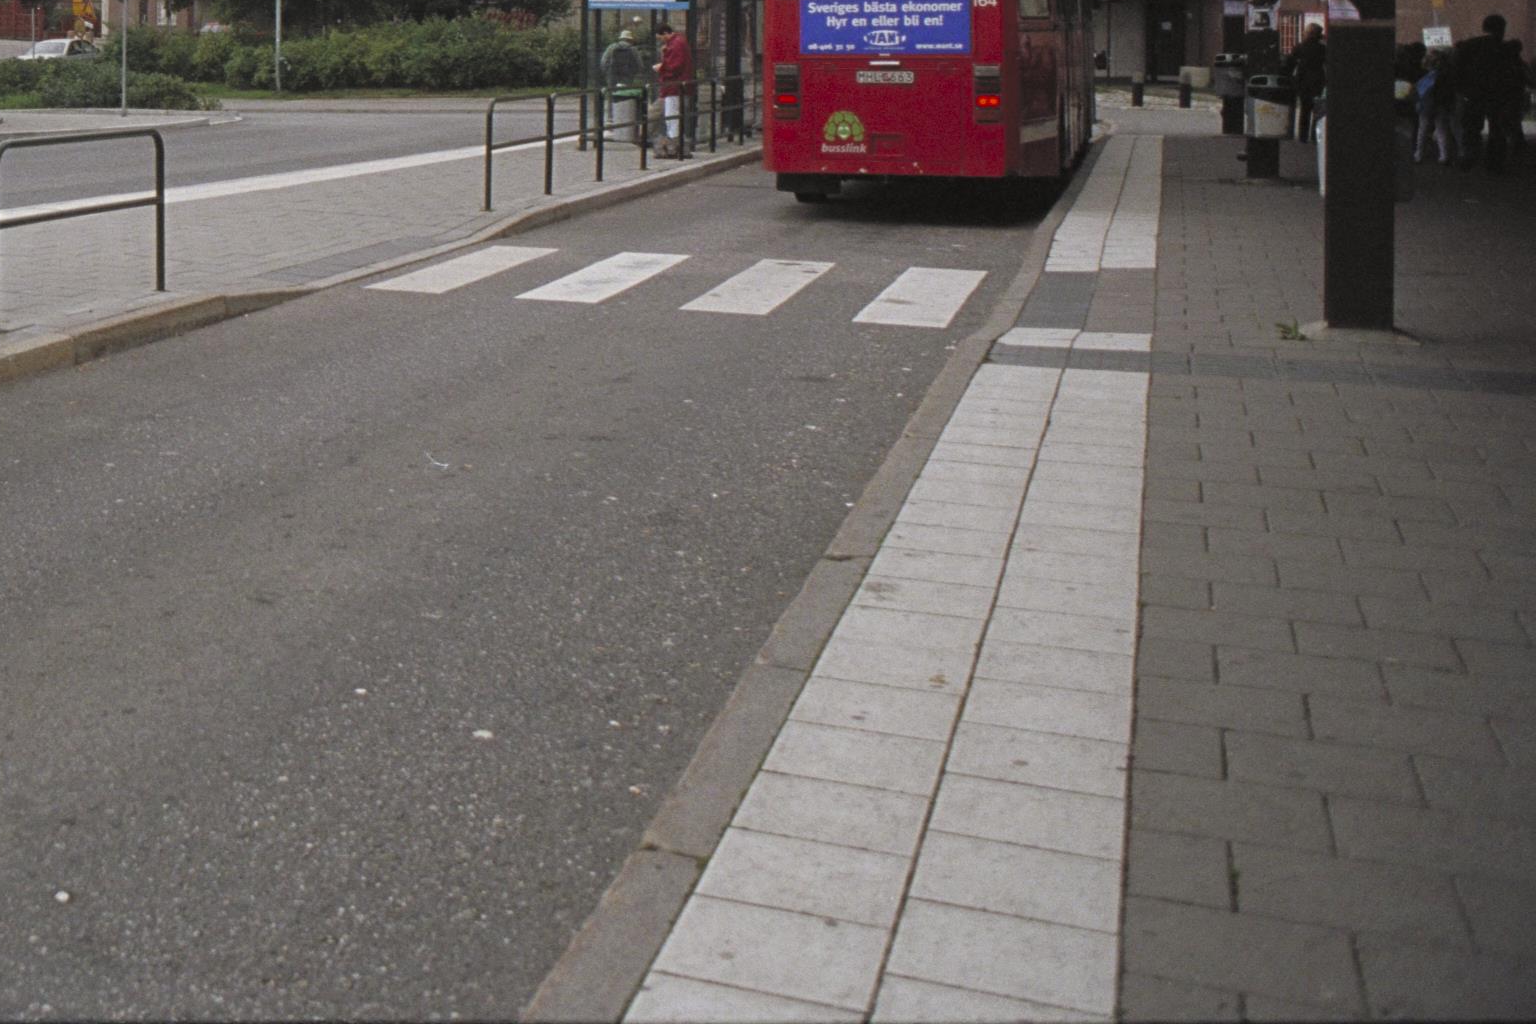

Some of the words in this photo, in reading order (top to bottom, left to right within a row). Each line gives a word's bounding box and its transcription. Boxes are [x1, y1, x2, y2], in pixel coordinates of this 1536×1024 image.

[808, 2, 859, 15] Sveriges
[864, 2, 897, 12] bästa
[902, 1, 962, 12] ekonomer
[826, 17, 848, 29] Hyr
[852, 18, 867, 26] en
[871, 16, 899, 26] eller
[904, 16, 920, 26] bli
[924, 15, 944, 26] en!
[821, 142, 867, 153] busslink
